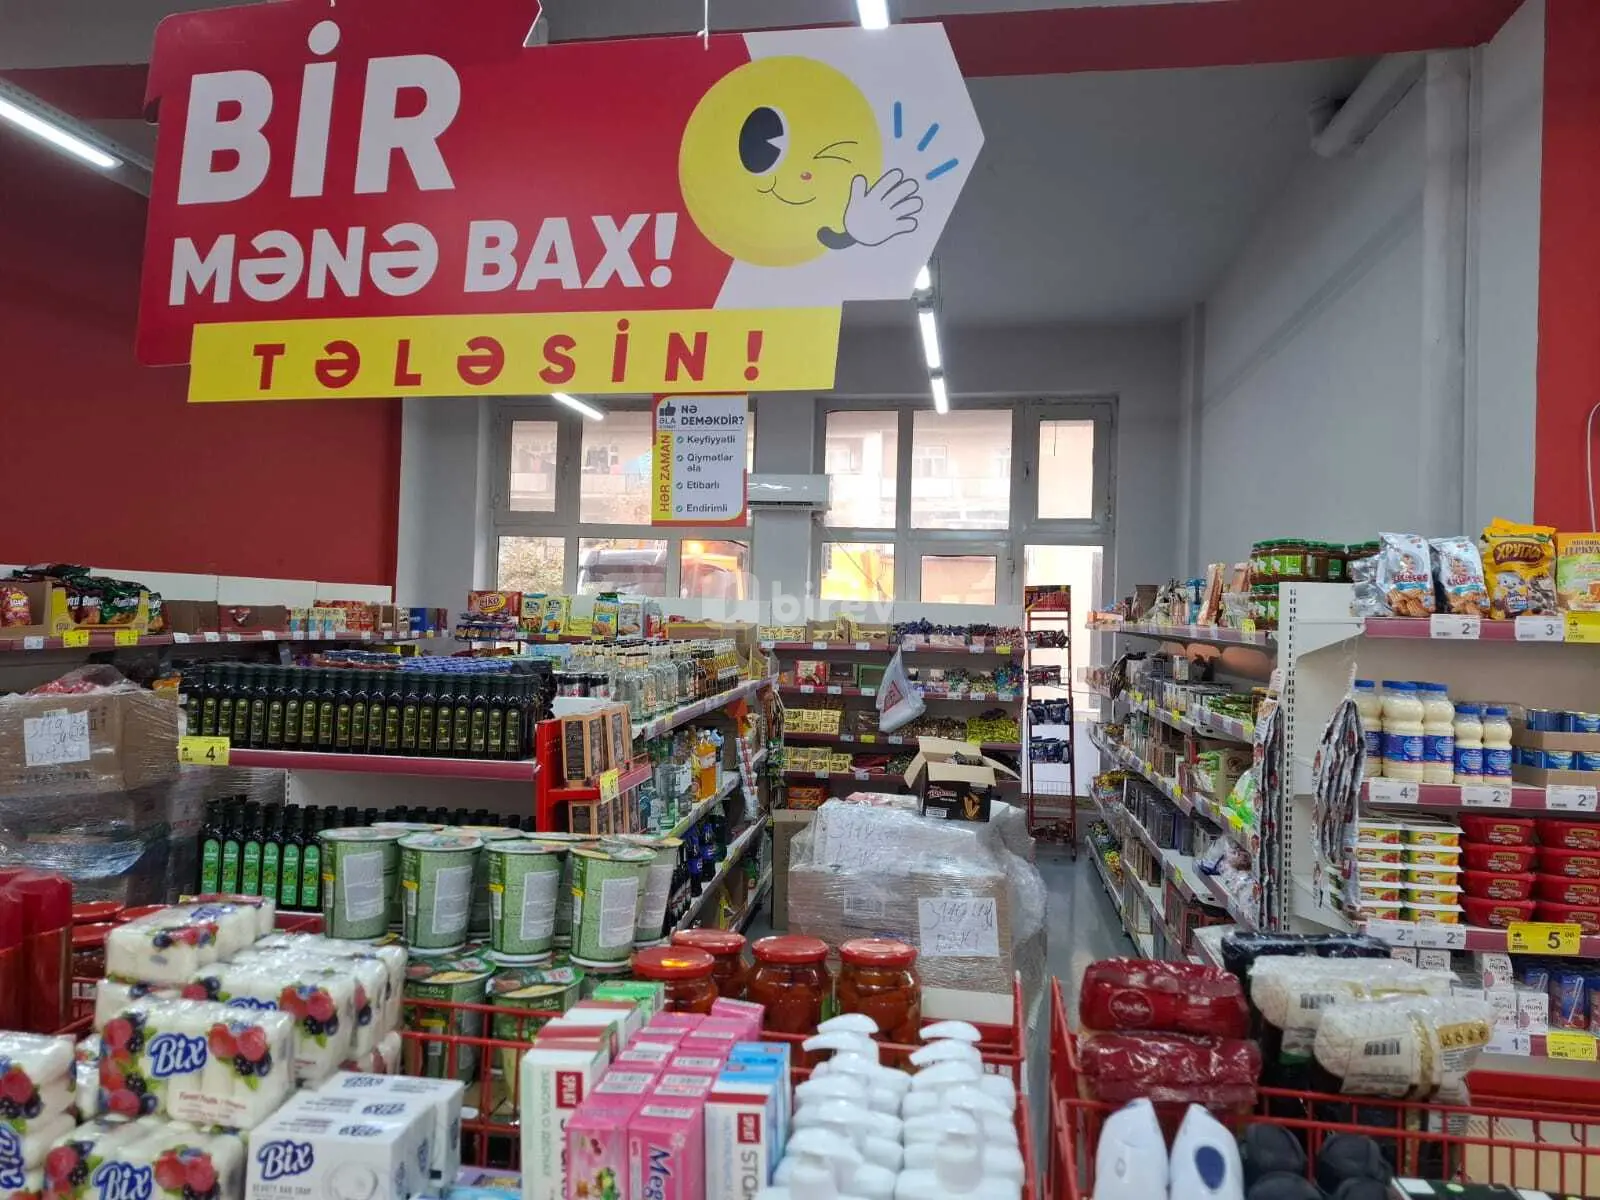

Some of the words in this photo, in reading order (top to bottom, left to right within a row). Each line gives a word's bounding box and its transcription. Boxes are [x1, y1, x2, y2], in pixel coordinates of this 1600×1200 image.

[176, 20, 462, 206] BİR
[168, 222, 439, 306] MƏNƏ
[463, 211, 678, 294] BAX!
[681, 404, 698, 414] NƏ
[681, 413, 745, 426] DEMƏKDİR?
[660, 434, 671, 481] ZAMAN
[659, 484, 670, 512] HƏR
[686, 503, 728, 512] Endirimli
[1461, 622, 1471, 635] 2
[1545, 623, 1554, 636] 3
[205, 745, 216, 761] 4
[1399, 787, 1408, 799] 4
[1492, 790, 1501, 802] 2
[1577, 793, 1587, 807] 2
[1397, 929, 1406, 941] 2
[1446, 931, 1456, 944] 2
[1547, 931, 1561, 949] 5
[149, 1033, 208, 1078] Bix
[562, 1074, 577, 1105] SPLAT
[258, 1140, 315, 1180] Bix
[93, 1162, 153, 1200] Bix
